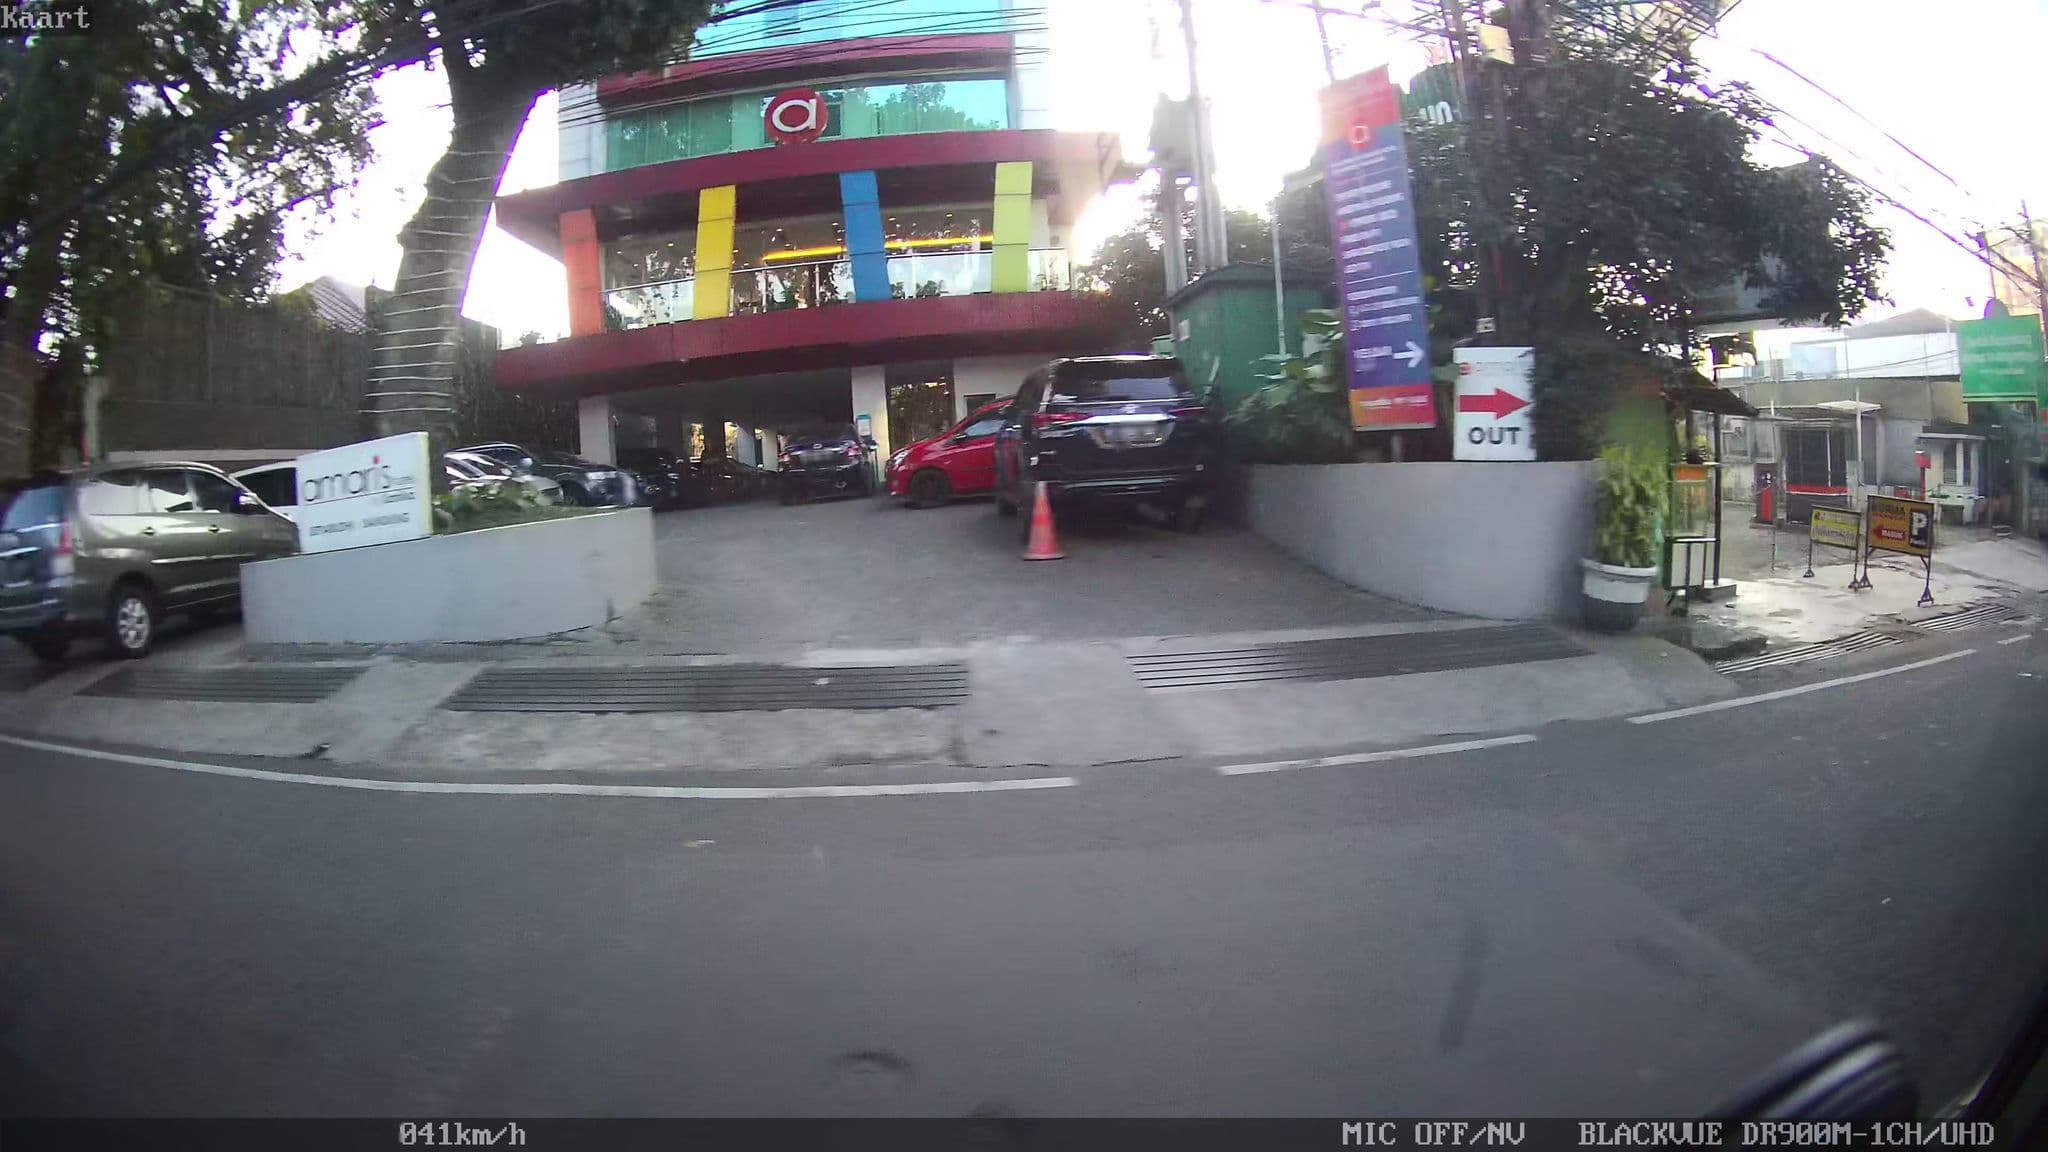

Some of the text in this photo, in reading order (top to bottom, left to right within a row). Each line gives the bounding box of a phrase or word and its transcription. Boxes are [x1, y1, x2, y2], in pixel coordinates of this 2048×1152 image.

[772, 99, 817, 133] a
[1468, 425, 1521, 446] OUT
[1911, 511, 1928, 536] P
